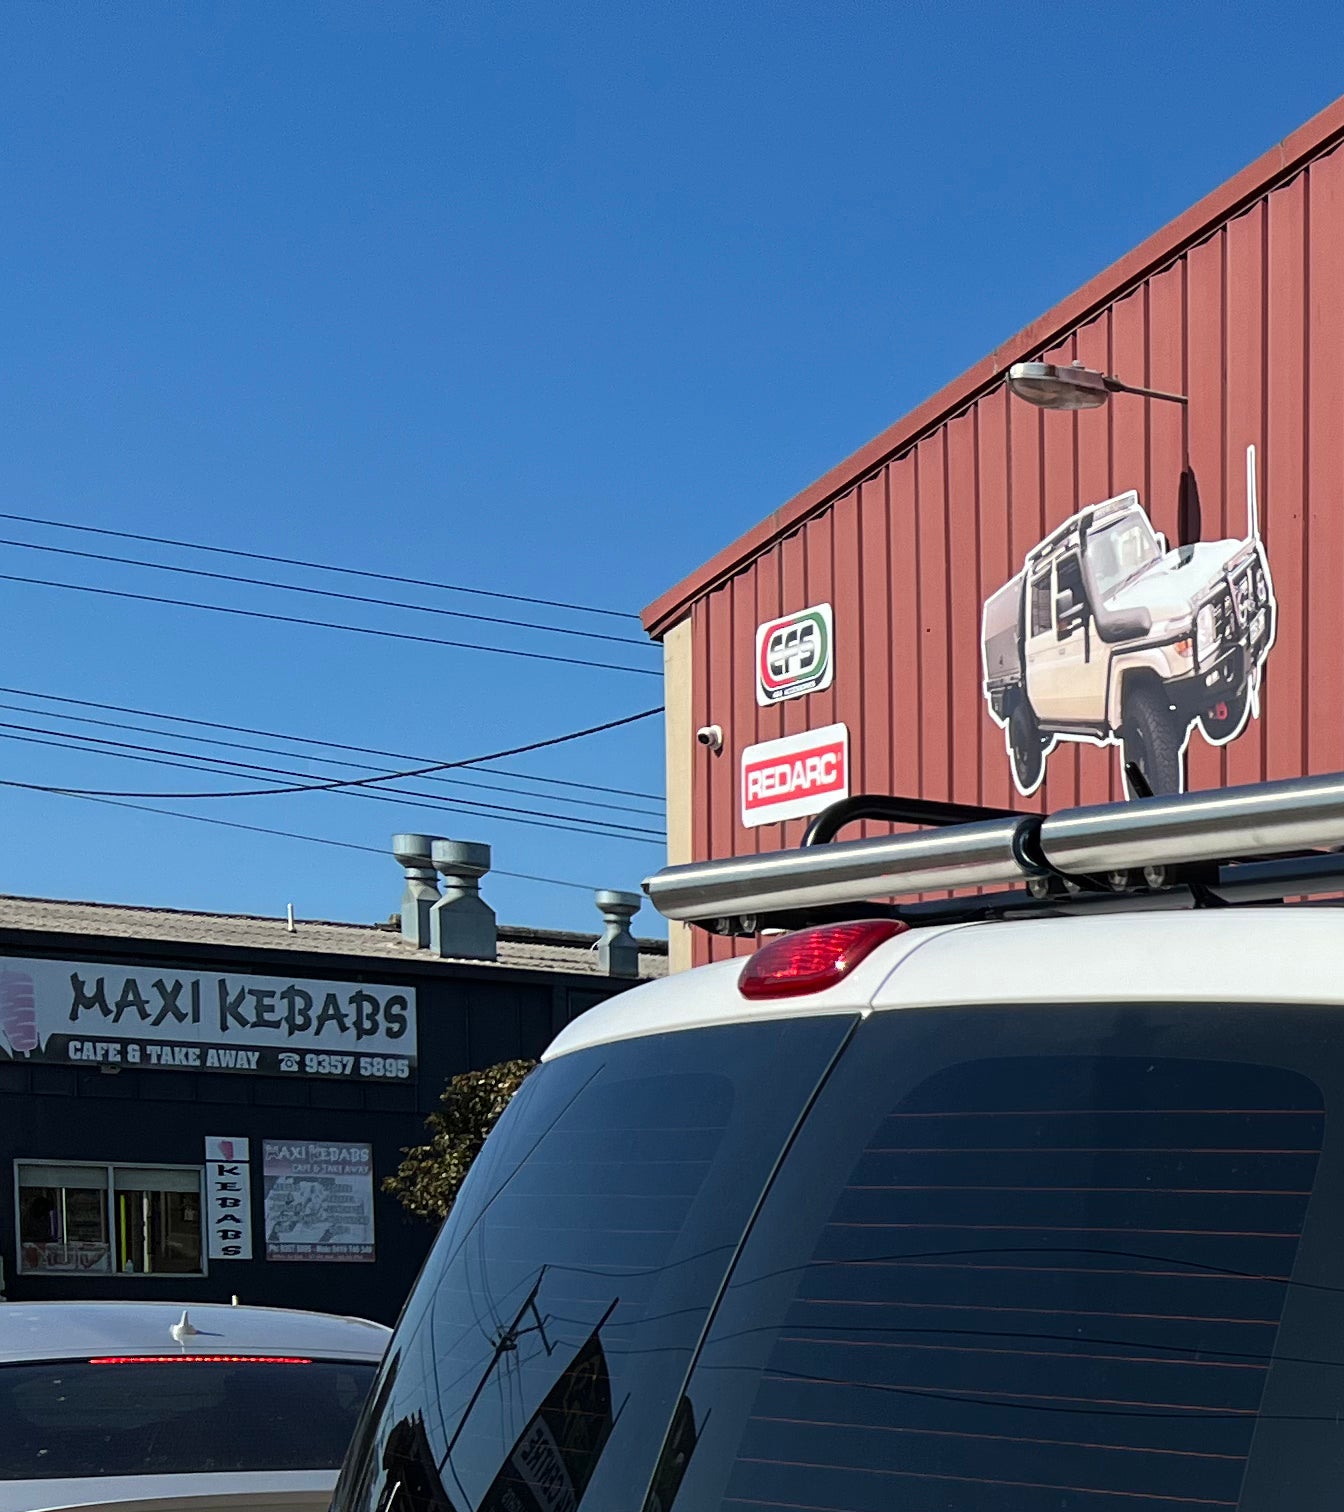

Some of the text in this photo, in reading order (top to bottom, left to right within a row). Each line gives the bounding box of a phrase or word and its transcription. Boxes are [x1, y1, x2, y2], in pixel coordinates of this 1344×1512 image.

[748, 752, 837, 801] REDARC
[68, 971, 409, 1041] MAXI KEBABS
[68, 1041, 410, 1079] CAFE & TAKE AWAY 9357 5895
[265, 1144, 370, 1163] MAXI KEBABS
[215, 1164, 243, 1257] KEBABS
